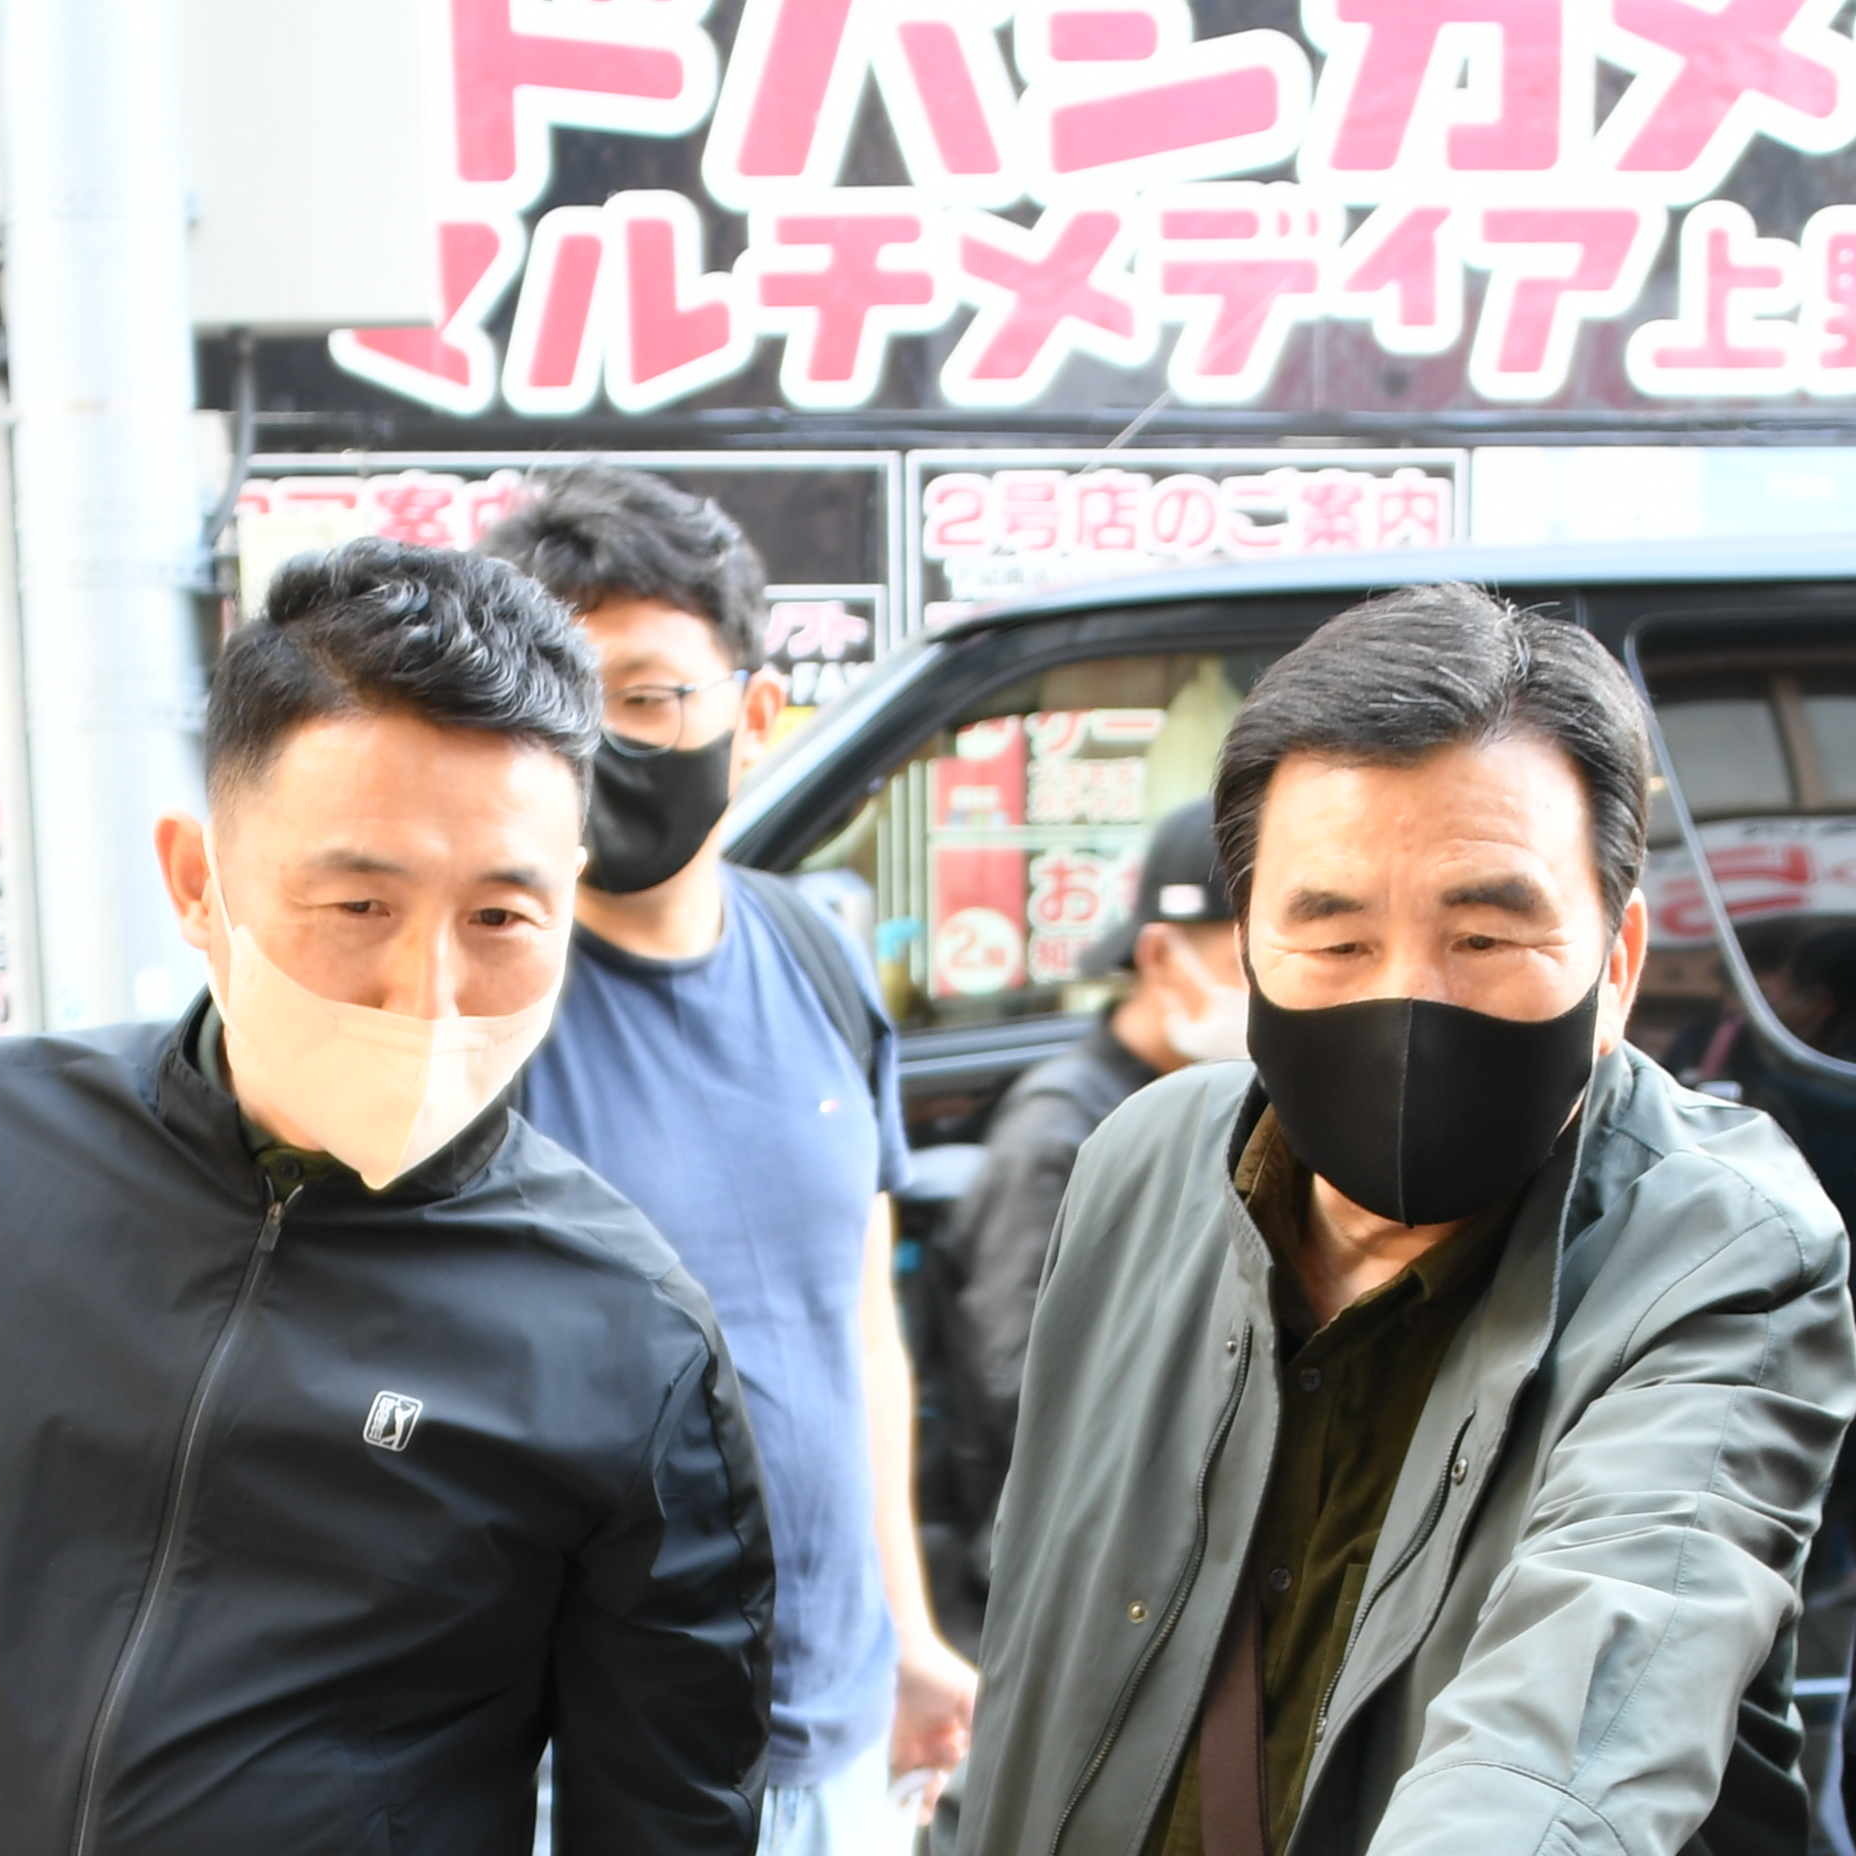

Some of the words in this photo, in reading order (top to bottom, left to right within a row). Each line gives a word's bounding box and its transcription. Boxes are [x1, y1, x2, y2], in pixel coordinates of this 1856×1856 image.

[925, 468, 1451, 557] 2号店のご案内
